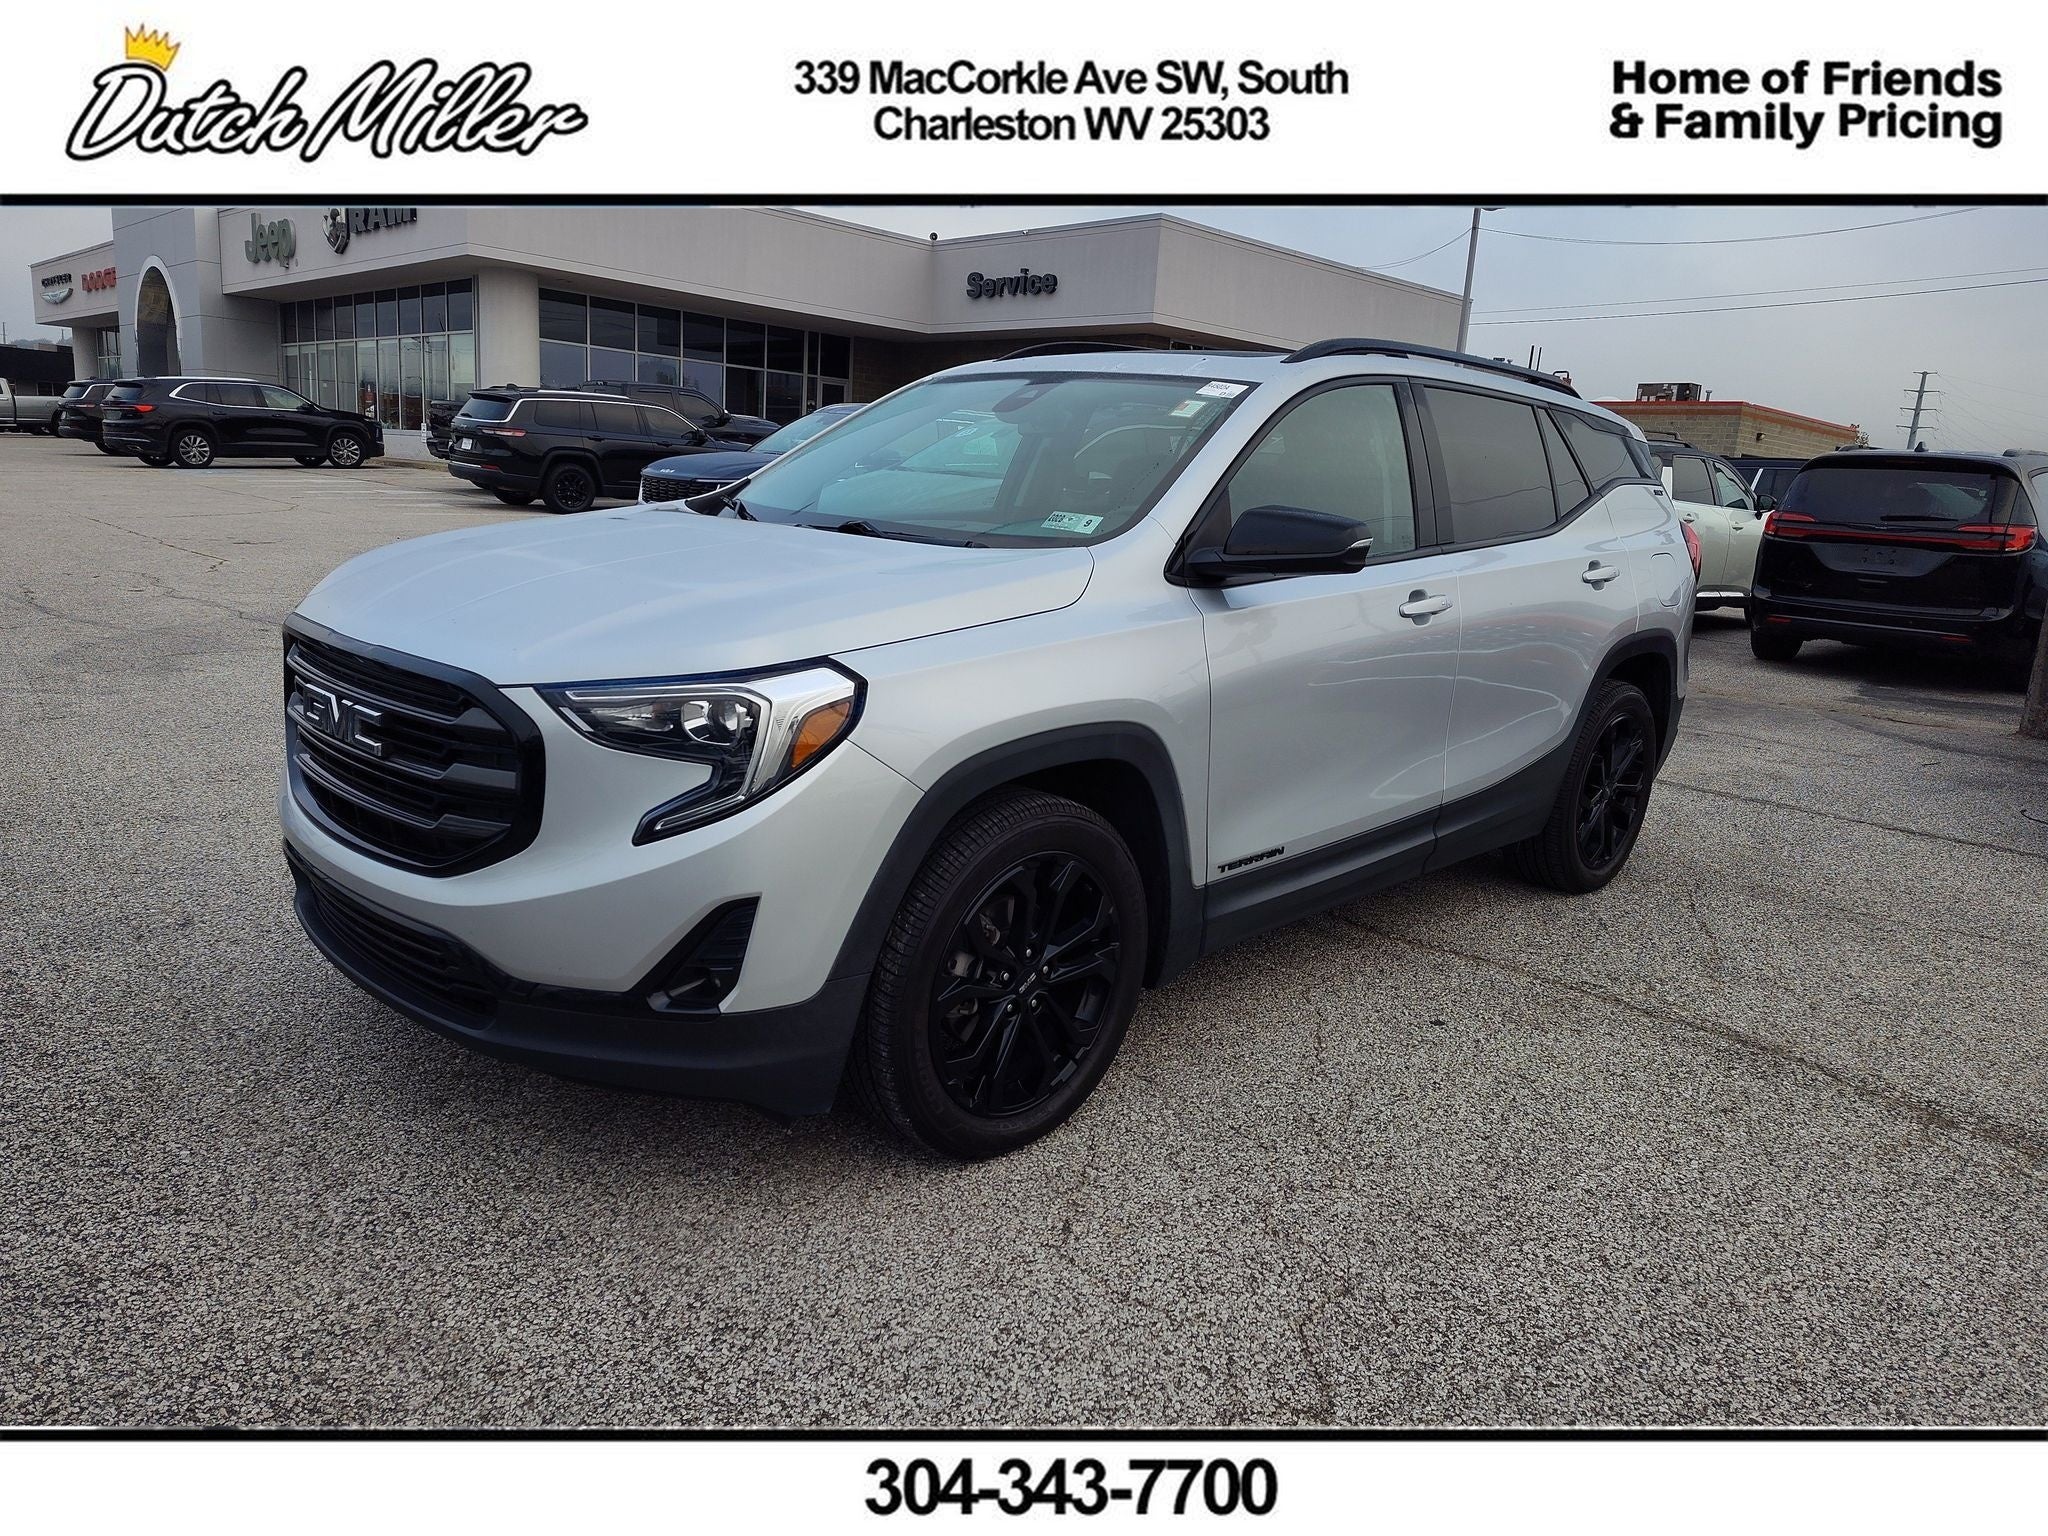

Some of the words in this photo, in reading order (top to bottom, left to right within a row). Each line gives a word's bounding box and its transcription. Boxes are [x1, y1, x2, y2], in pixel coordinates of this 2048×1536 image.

[349, 207, 418, 234] RAM
[243, 212, 297, 269] Jeep
[81, 266, 117, 293] DODGE
[966, 267, 1059, 299] Service
[302, 683, 383, 757] GMC
[1217, 846, 1285, 874] TERRAIN
